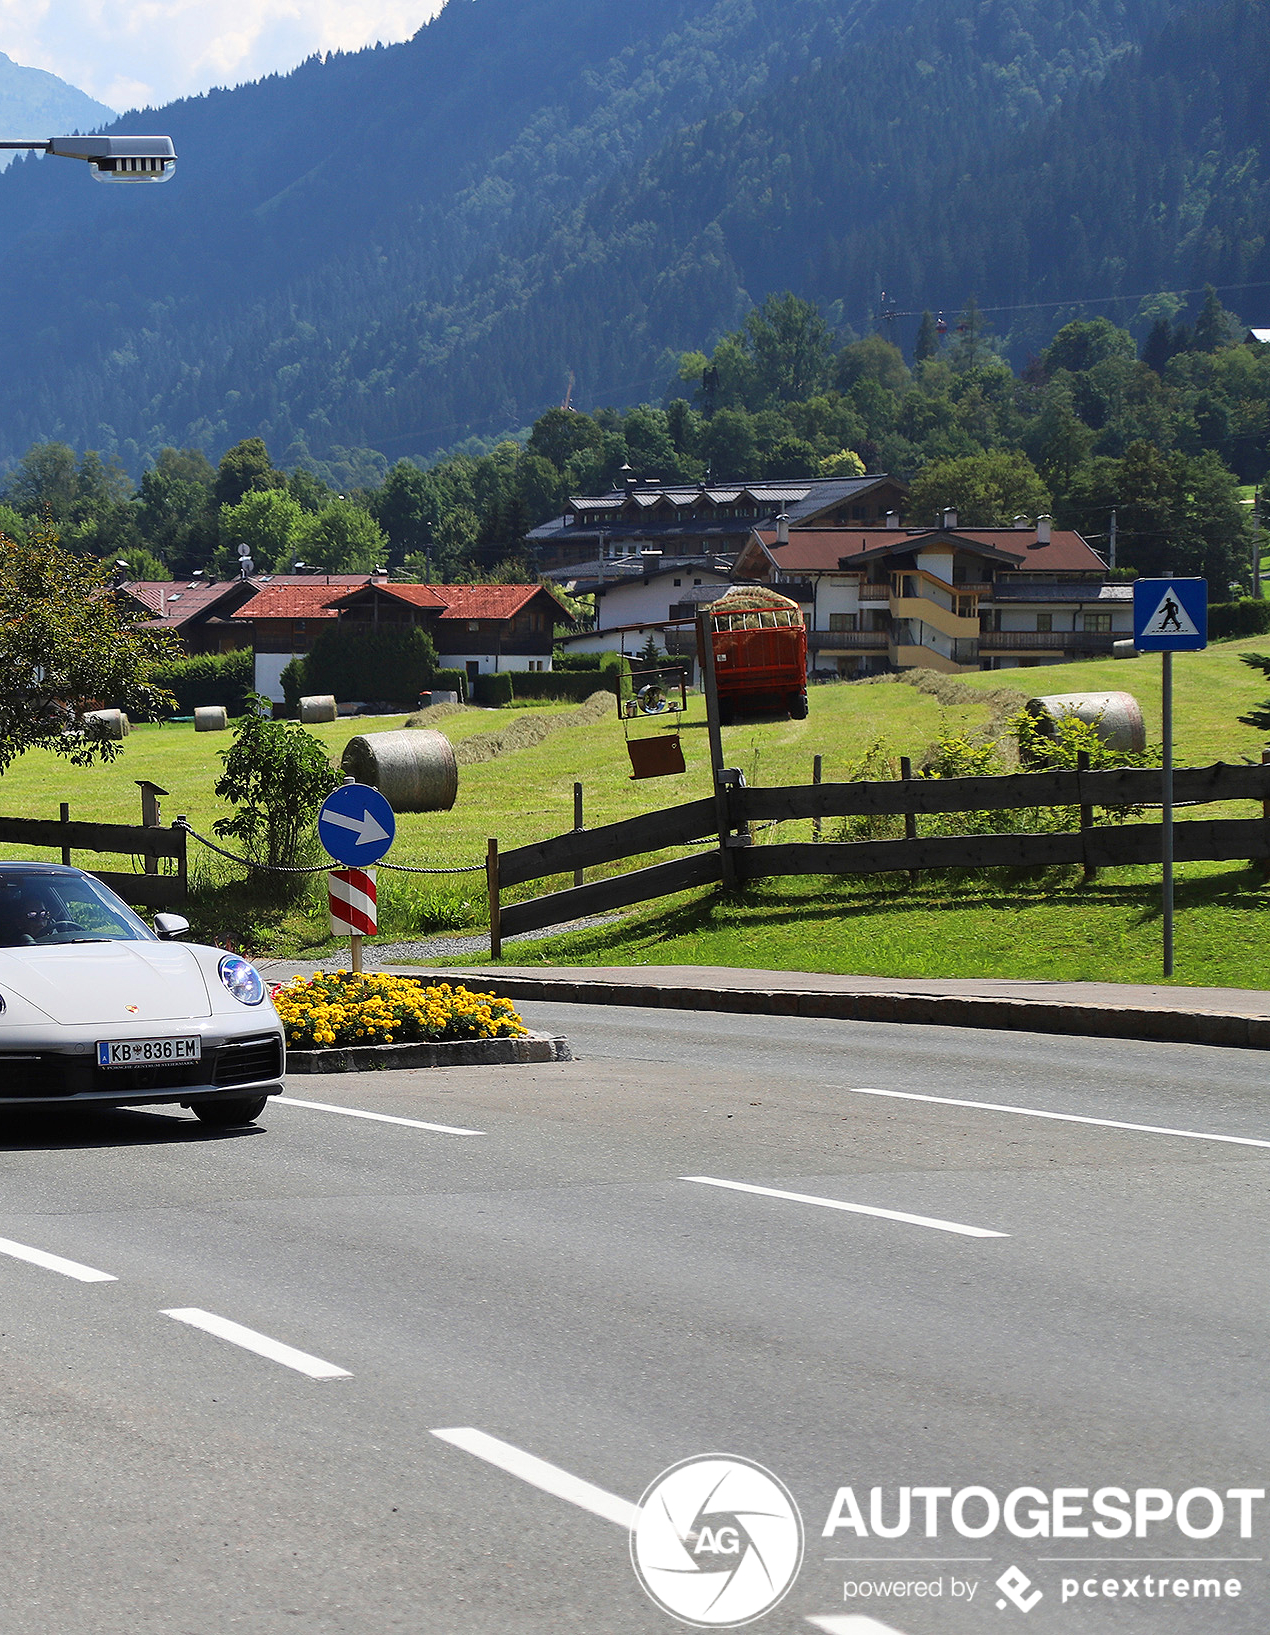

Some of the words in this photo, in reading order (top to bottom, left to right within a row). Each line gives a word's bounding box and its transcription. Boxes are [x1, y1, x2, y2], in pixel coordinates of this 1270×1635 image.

[112, 1044, 131, 1061] KB
[143, 1042, 172, 1059] 836
[176, 1040, 195, 1057] EM
